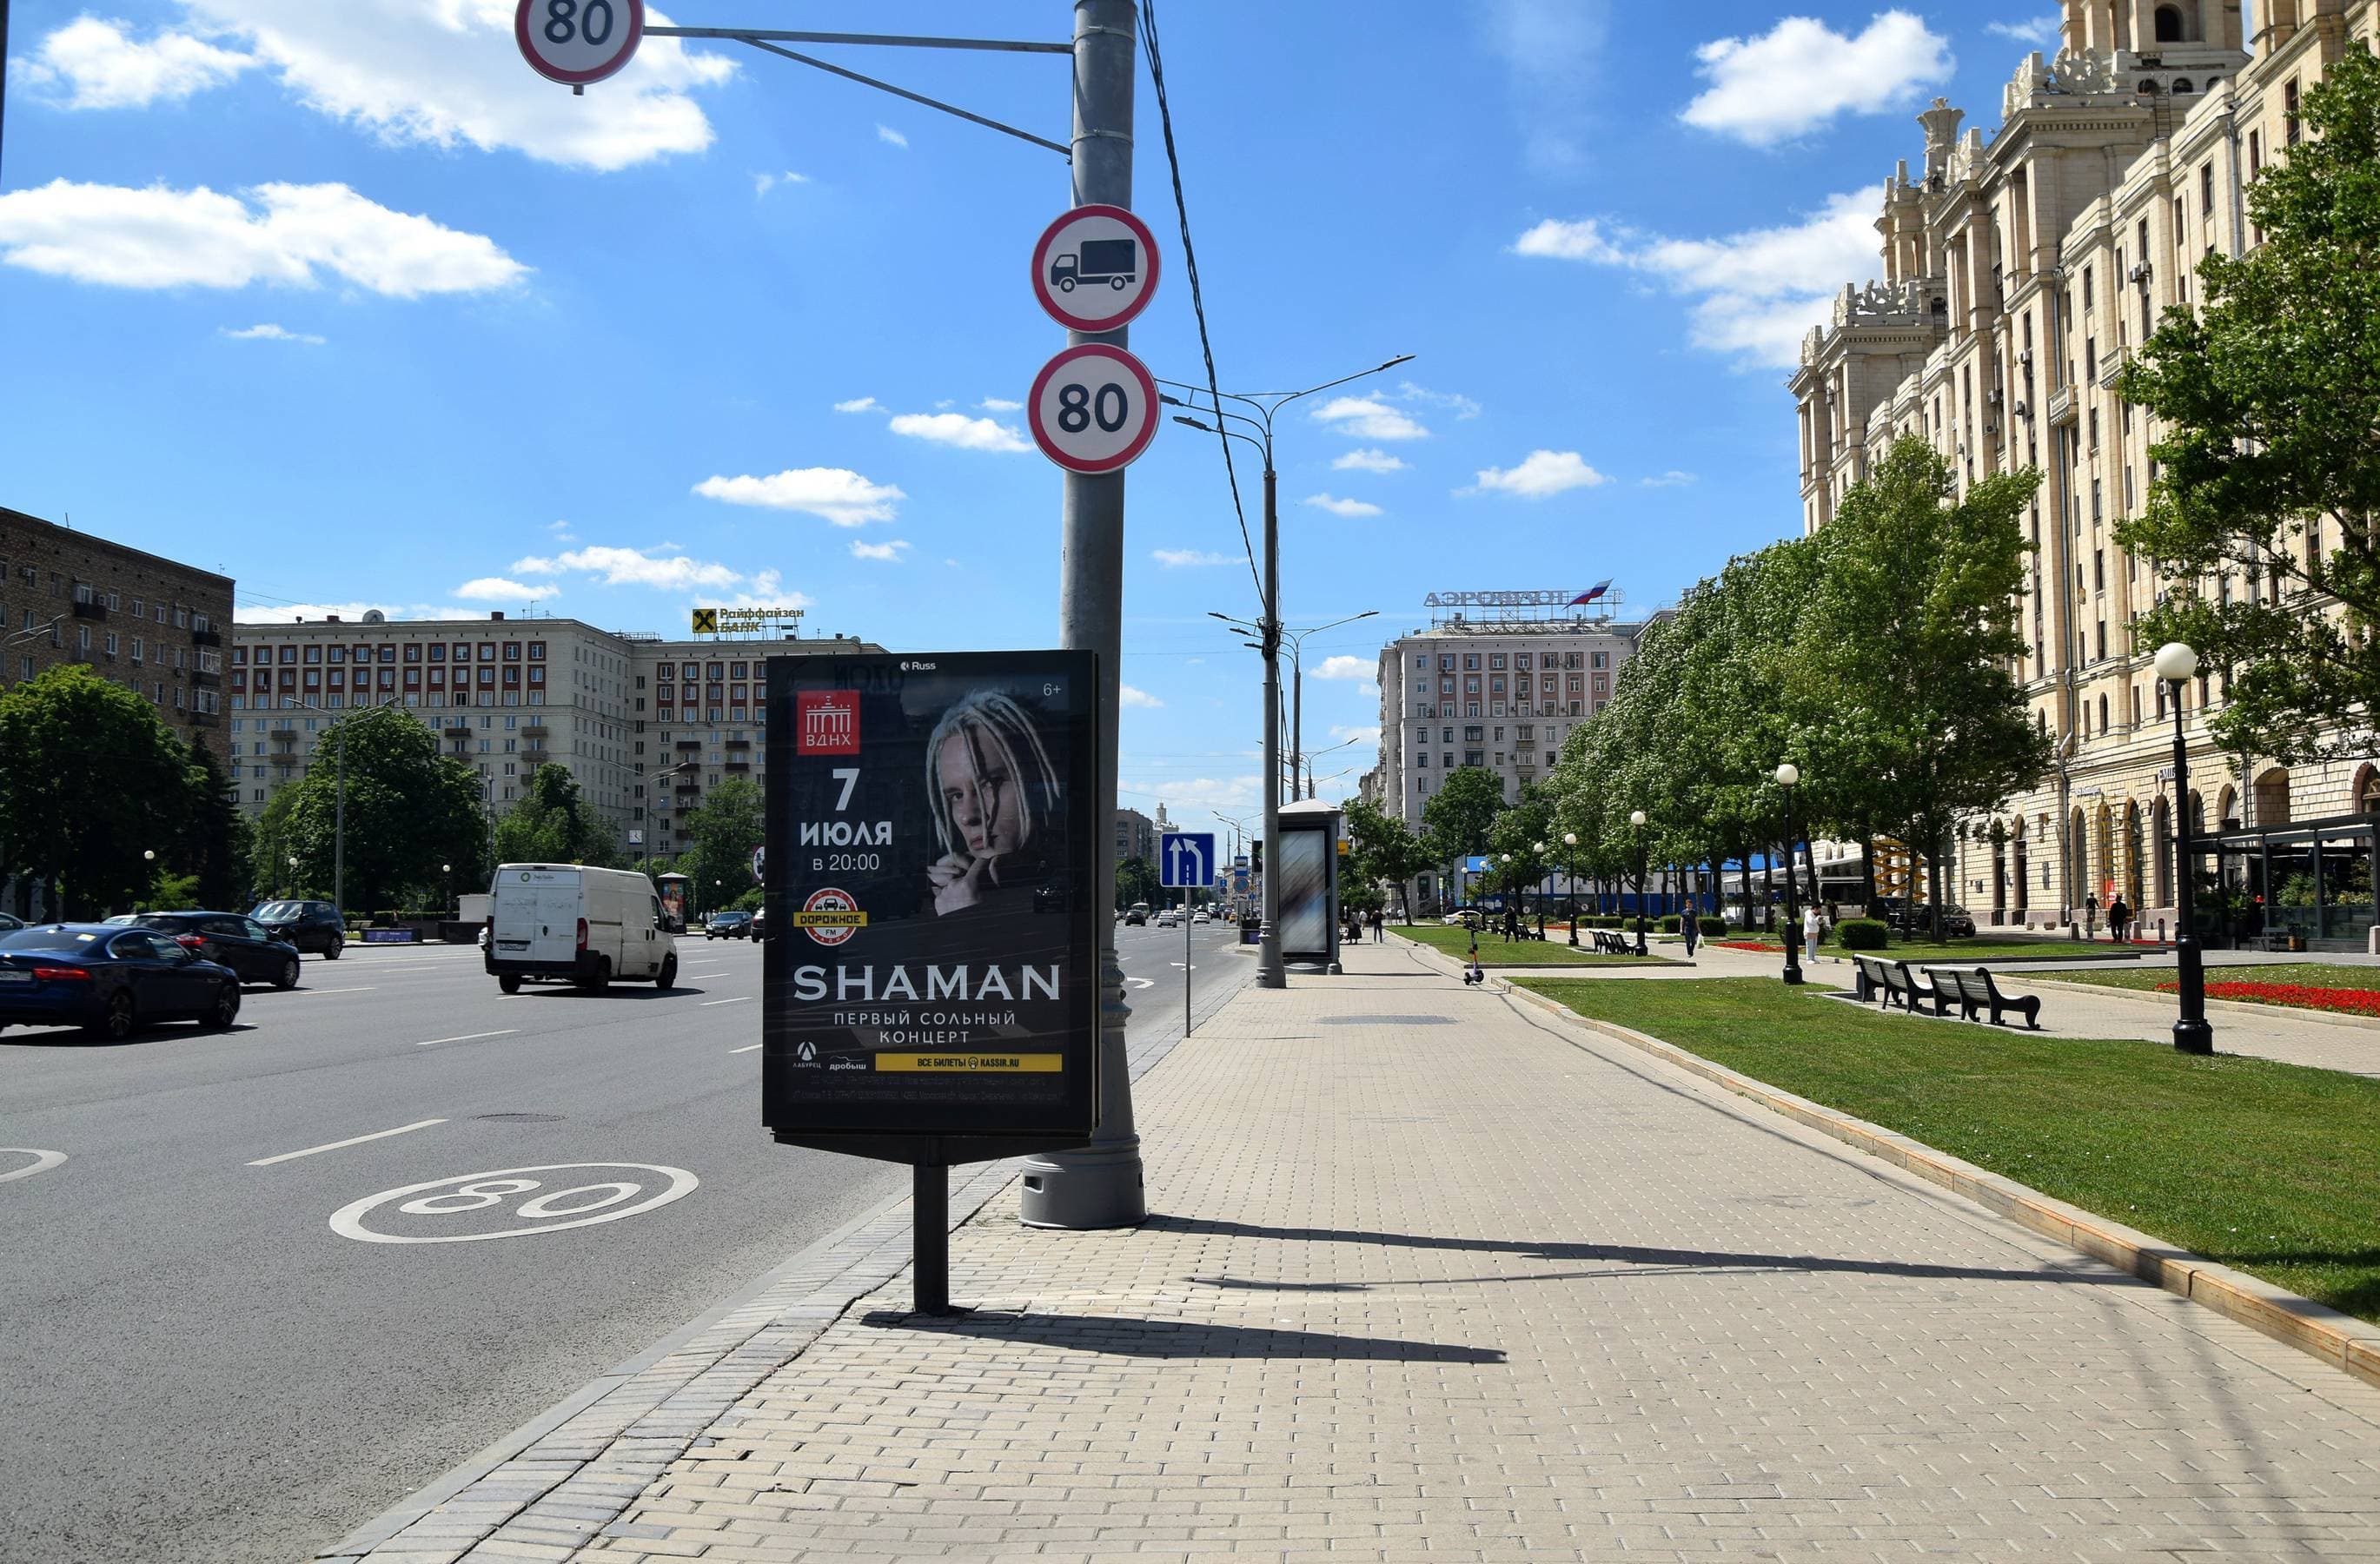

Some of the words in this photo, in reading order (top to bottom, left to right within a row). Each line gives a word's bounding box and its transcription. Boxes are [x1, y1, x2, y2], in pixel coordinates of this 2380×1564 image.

[544, 0, 613, 46] 80
[1057, 382, 1129, 434] 80
[1423, 590, 1563, 606] АЭРОФЛОТ
[719, 607, 805, 620] Райффайзен
[719, 621, 761, 633] БАНК
[912, 661, 937, 671] Russ
[1043, 683, 1062, 697] 6+
[806, 734, 852, 747] ВДНХ
[832, 768, 860, 812] 7
[800, 820, 892, 846] ИЮЛЯ
[812, 858, 823, 871] в
[829, 853, 880, 871] 20:00
[799, 915, 861, 925] ДОРОЖНОЕ
[793, 964, 1060, 1000] SHAMAN
[834, 1010, 911, 1025] ПЕРВЫЙ
[920, 1010, 1016, 1025] СОЛЬНЫЙ
[879, 1031, 970, 1045] КОНЦЕРТ
[829, 1061, 866, 1070] дробыш
[917, 1058, 932, 1067] ВСЕ
[933, 1058, 966, 1067] БИЛЕТЫ
[980, 1057, 1020, 1068] KASSIR.RU
[400, 1179, 642, 1219] 80
